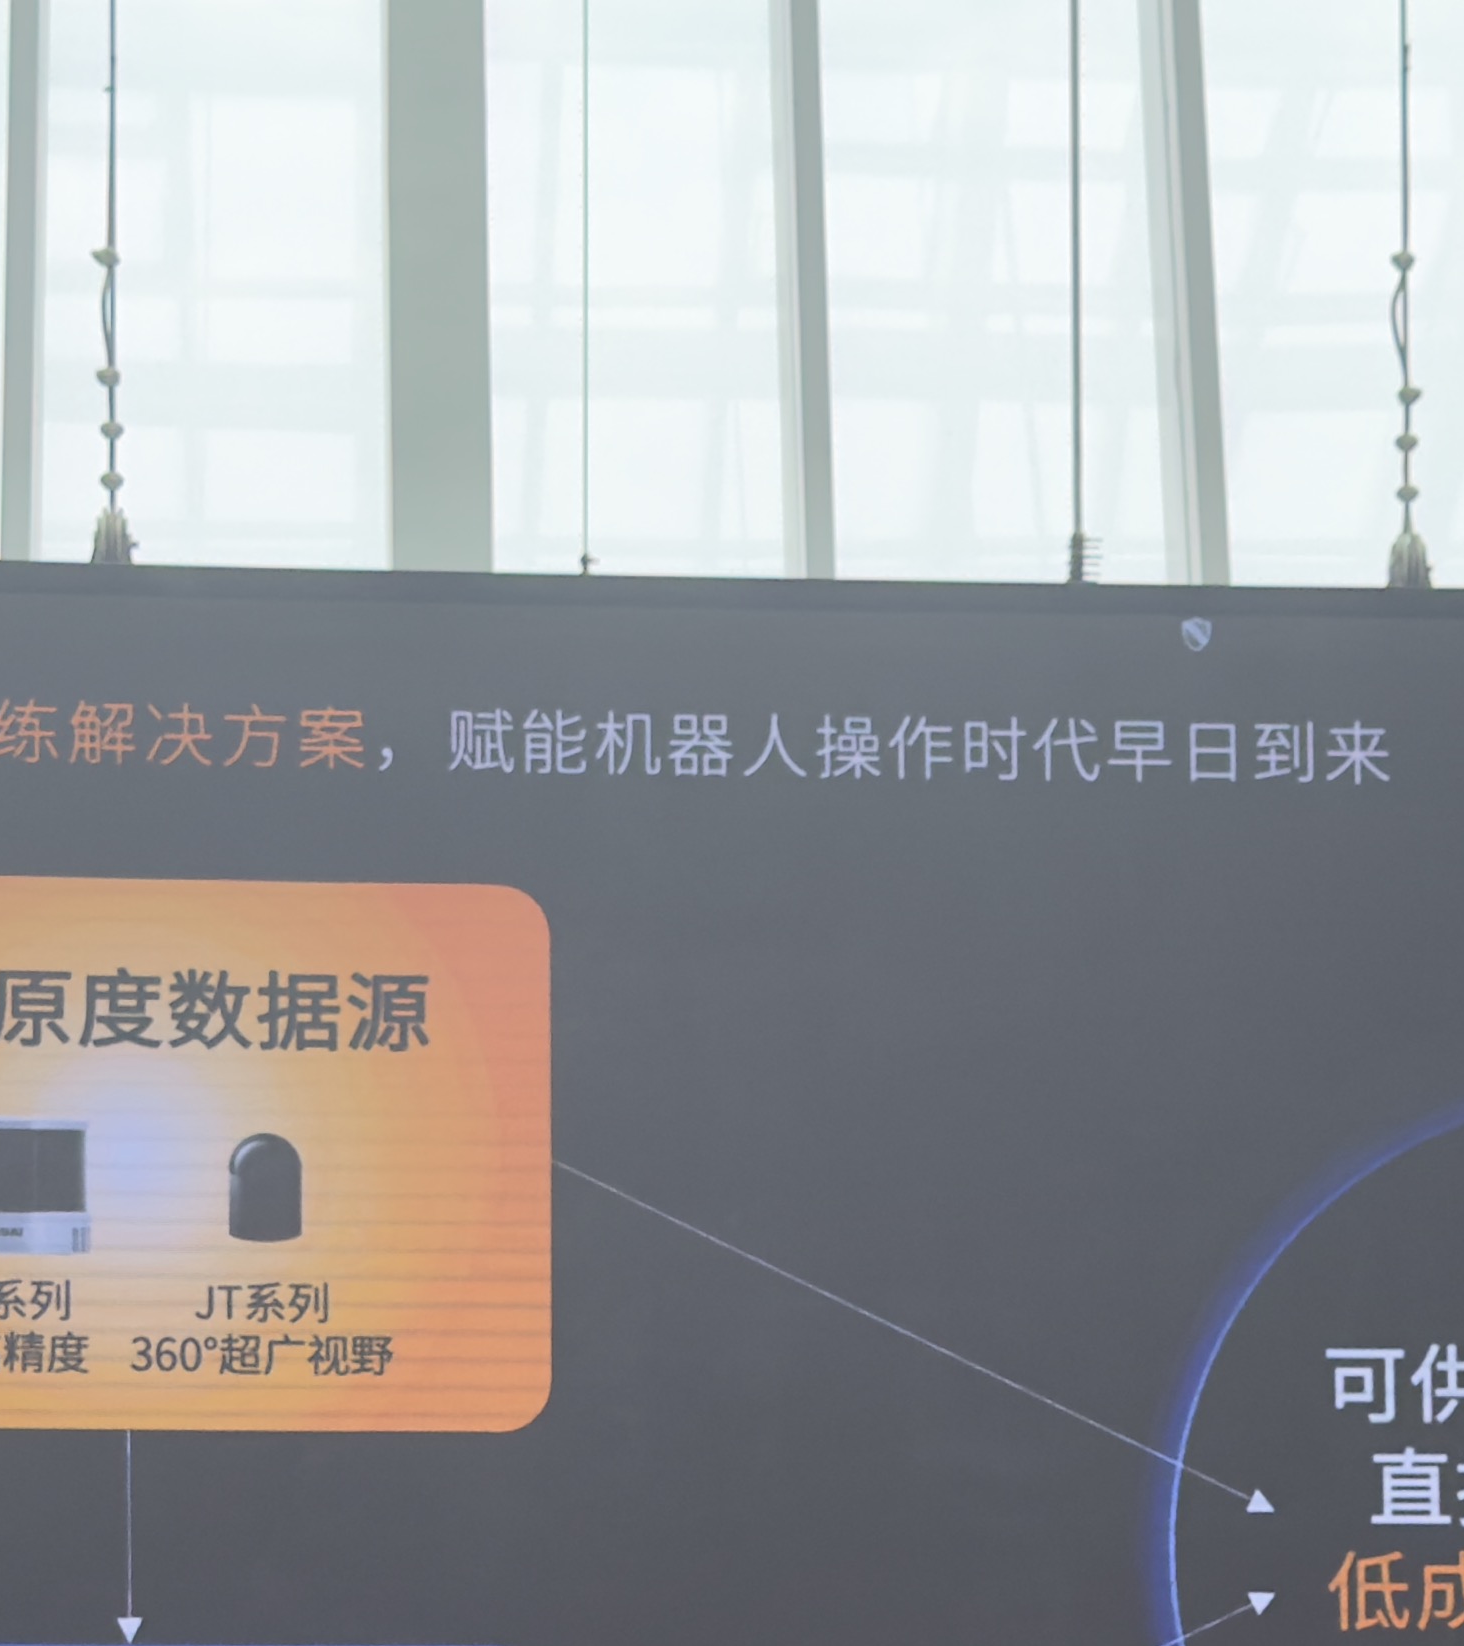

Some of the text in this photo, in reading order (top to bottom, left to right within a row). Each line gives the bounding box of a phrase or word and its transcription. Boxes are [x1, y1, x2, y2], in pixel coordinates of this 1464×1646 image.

[194, 1281, 330, 1324] JT系列
[129, 1334, 394, 1376] 360°超广视野
